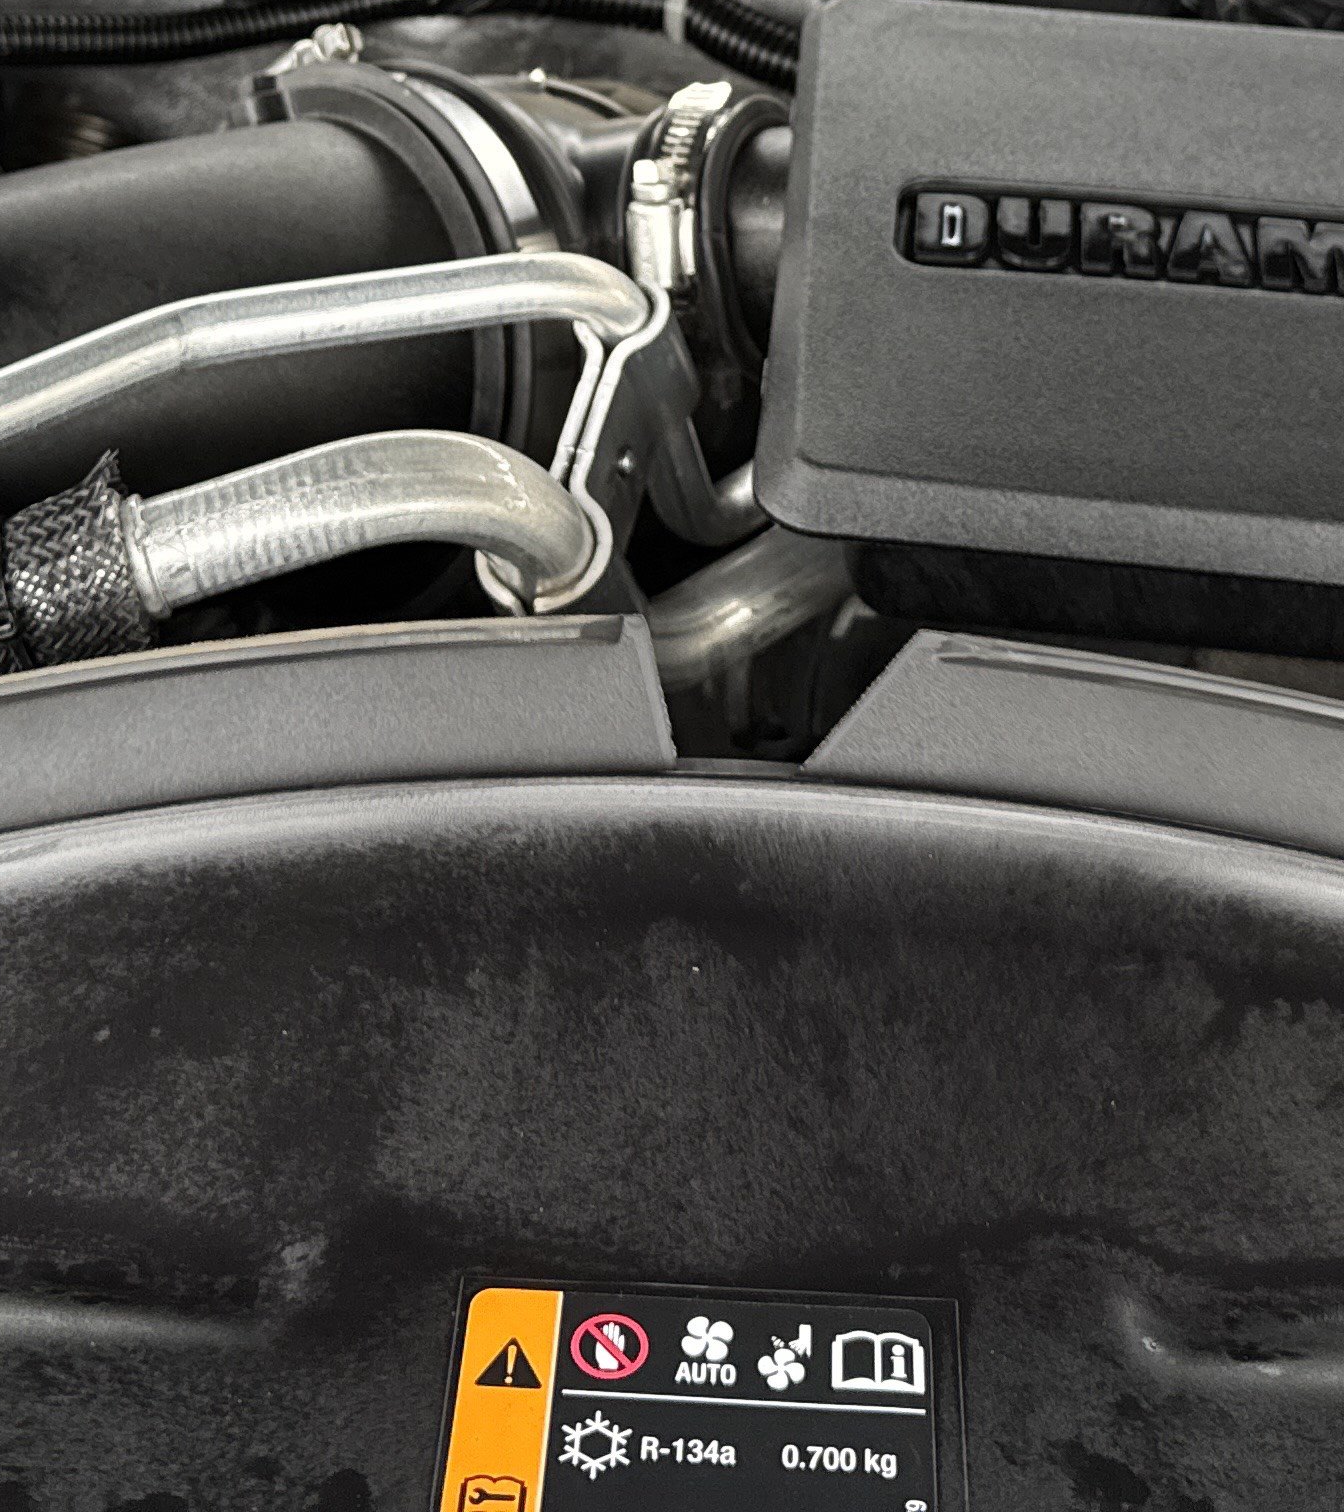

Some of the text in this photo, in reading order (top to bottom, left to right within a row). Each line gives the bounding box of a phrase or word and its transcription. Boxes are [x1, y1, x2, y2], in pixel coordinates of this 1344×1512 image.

[675, 1362, 737, 1386] AUTO
[640, 1436, 898, 1479] R-134a 0.700 kg
